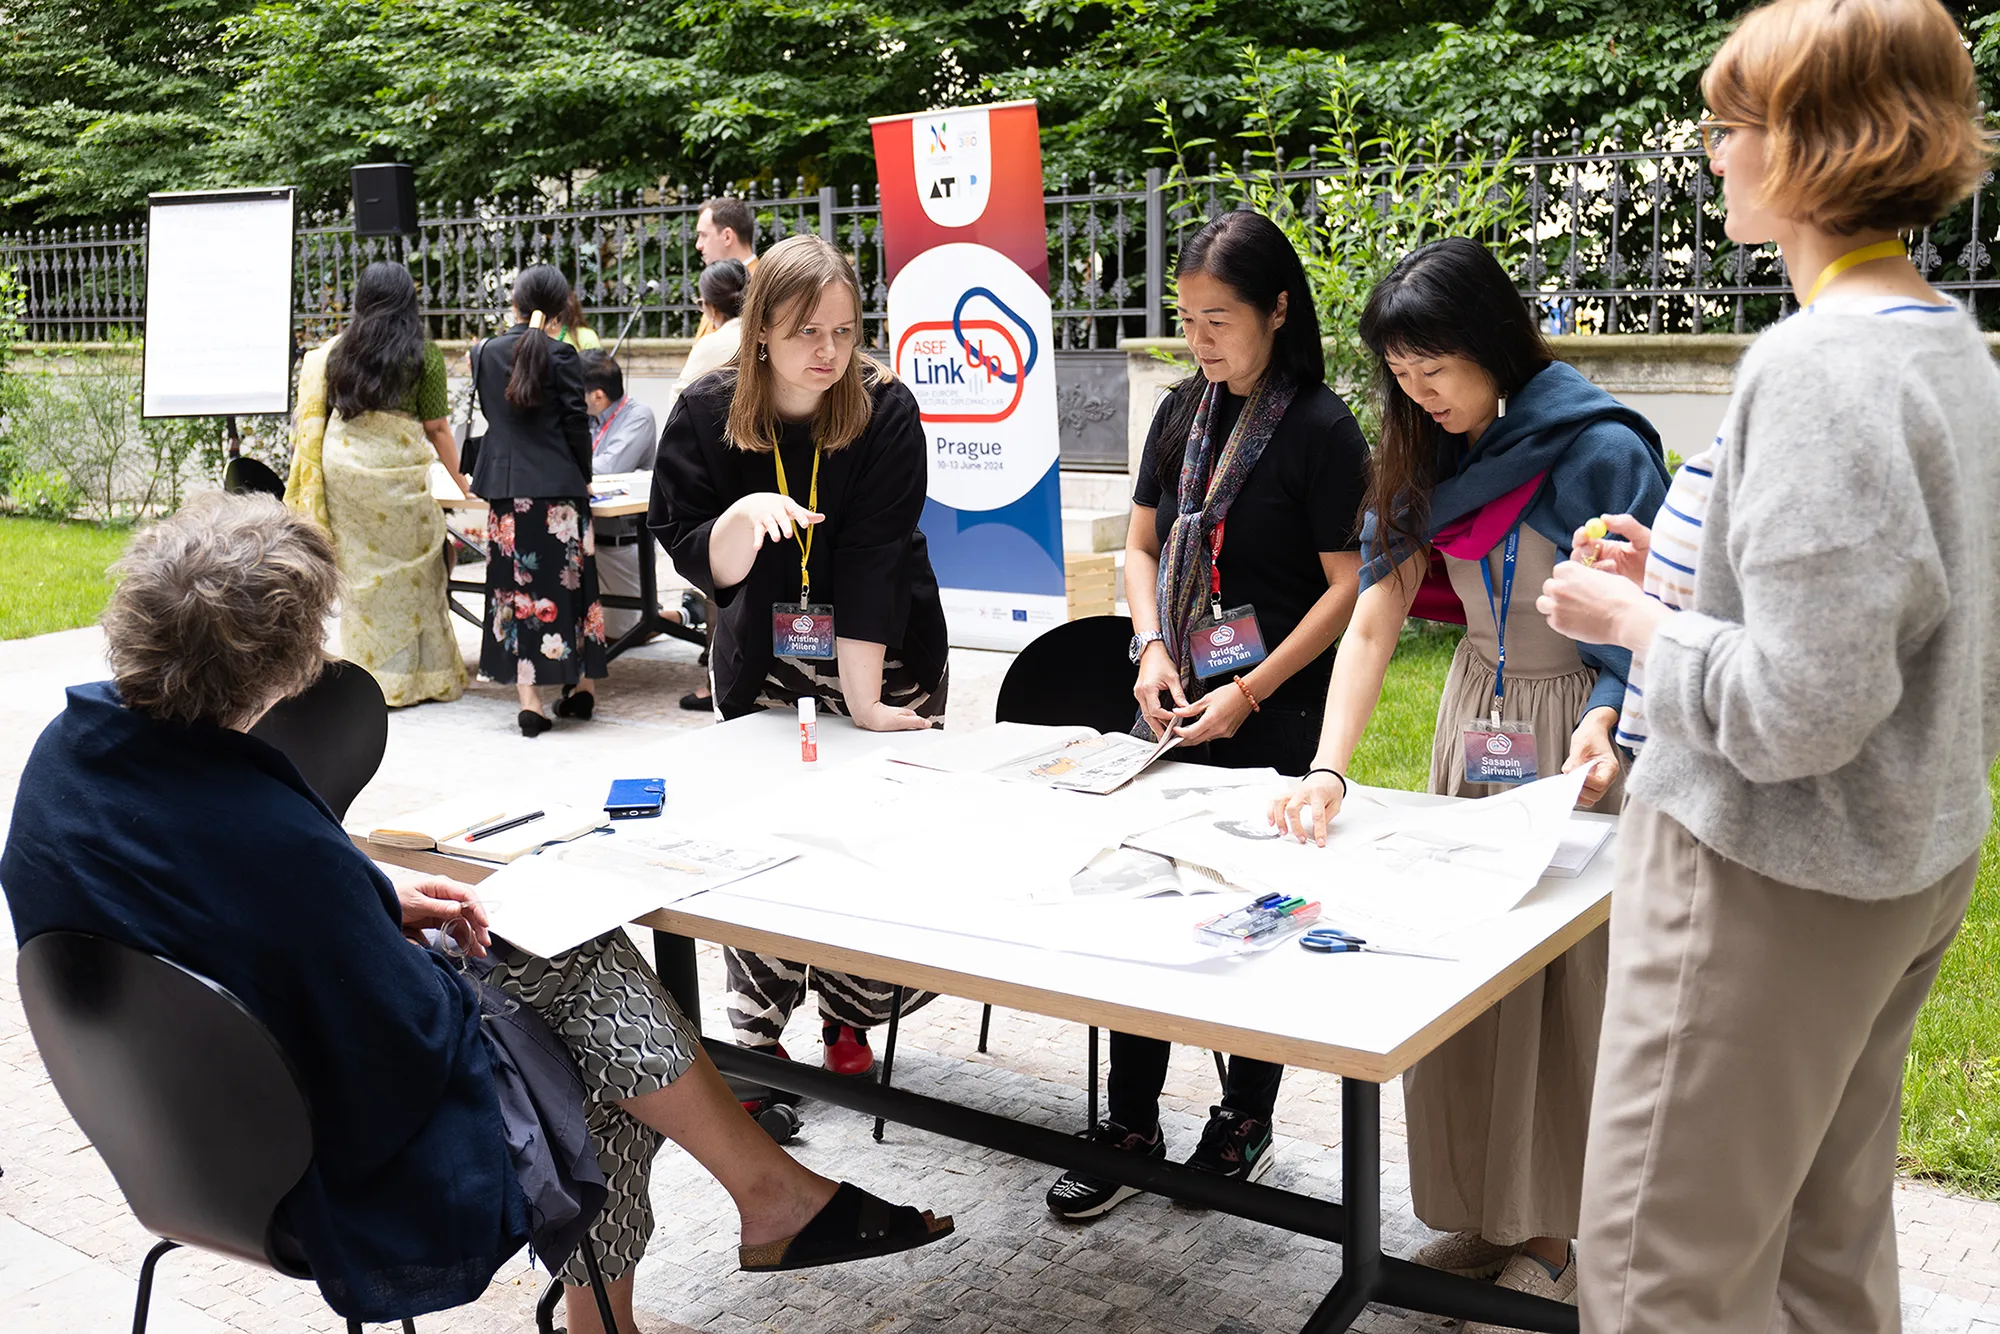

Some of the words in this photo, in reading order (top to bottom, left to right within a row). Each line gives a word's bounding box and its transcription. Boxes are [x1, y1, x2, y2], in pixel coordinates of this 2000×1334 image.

[914, 340, 947, 355] ASEF
[914, 357, 965, 384] Link
[963, 339, 1002, 383] Up
[937, 437, 1002, 460] Prague
[937, 461, 959, 469] 10-13
[960, 461, 982, 470] June
[984, 461, 1004, 470] 2024
[788, 635, 819, 643] Kristine
[1210, 643, 1244, 658] Bridget
[1208, 656, 1233, 667] Tracy
[1234, 651, 1251, 661] Tan
[1481, 757, 1520, 768] Sasapin
[1481, 766, 1522, 778] Siriwanij
